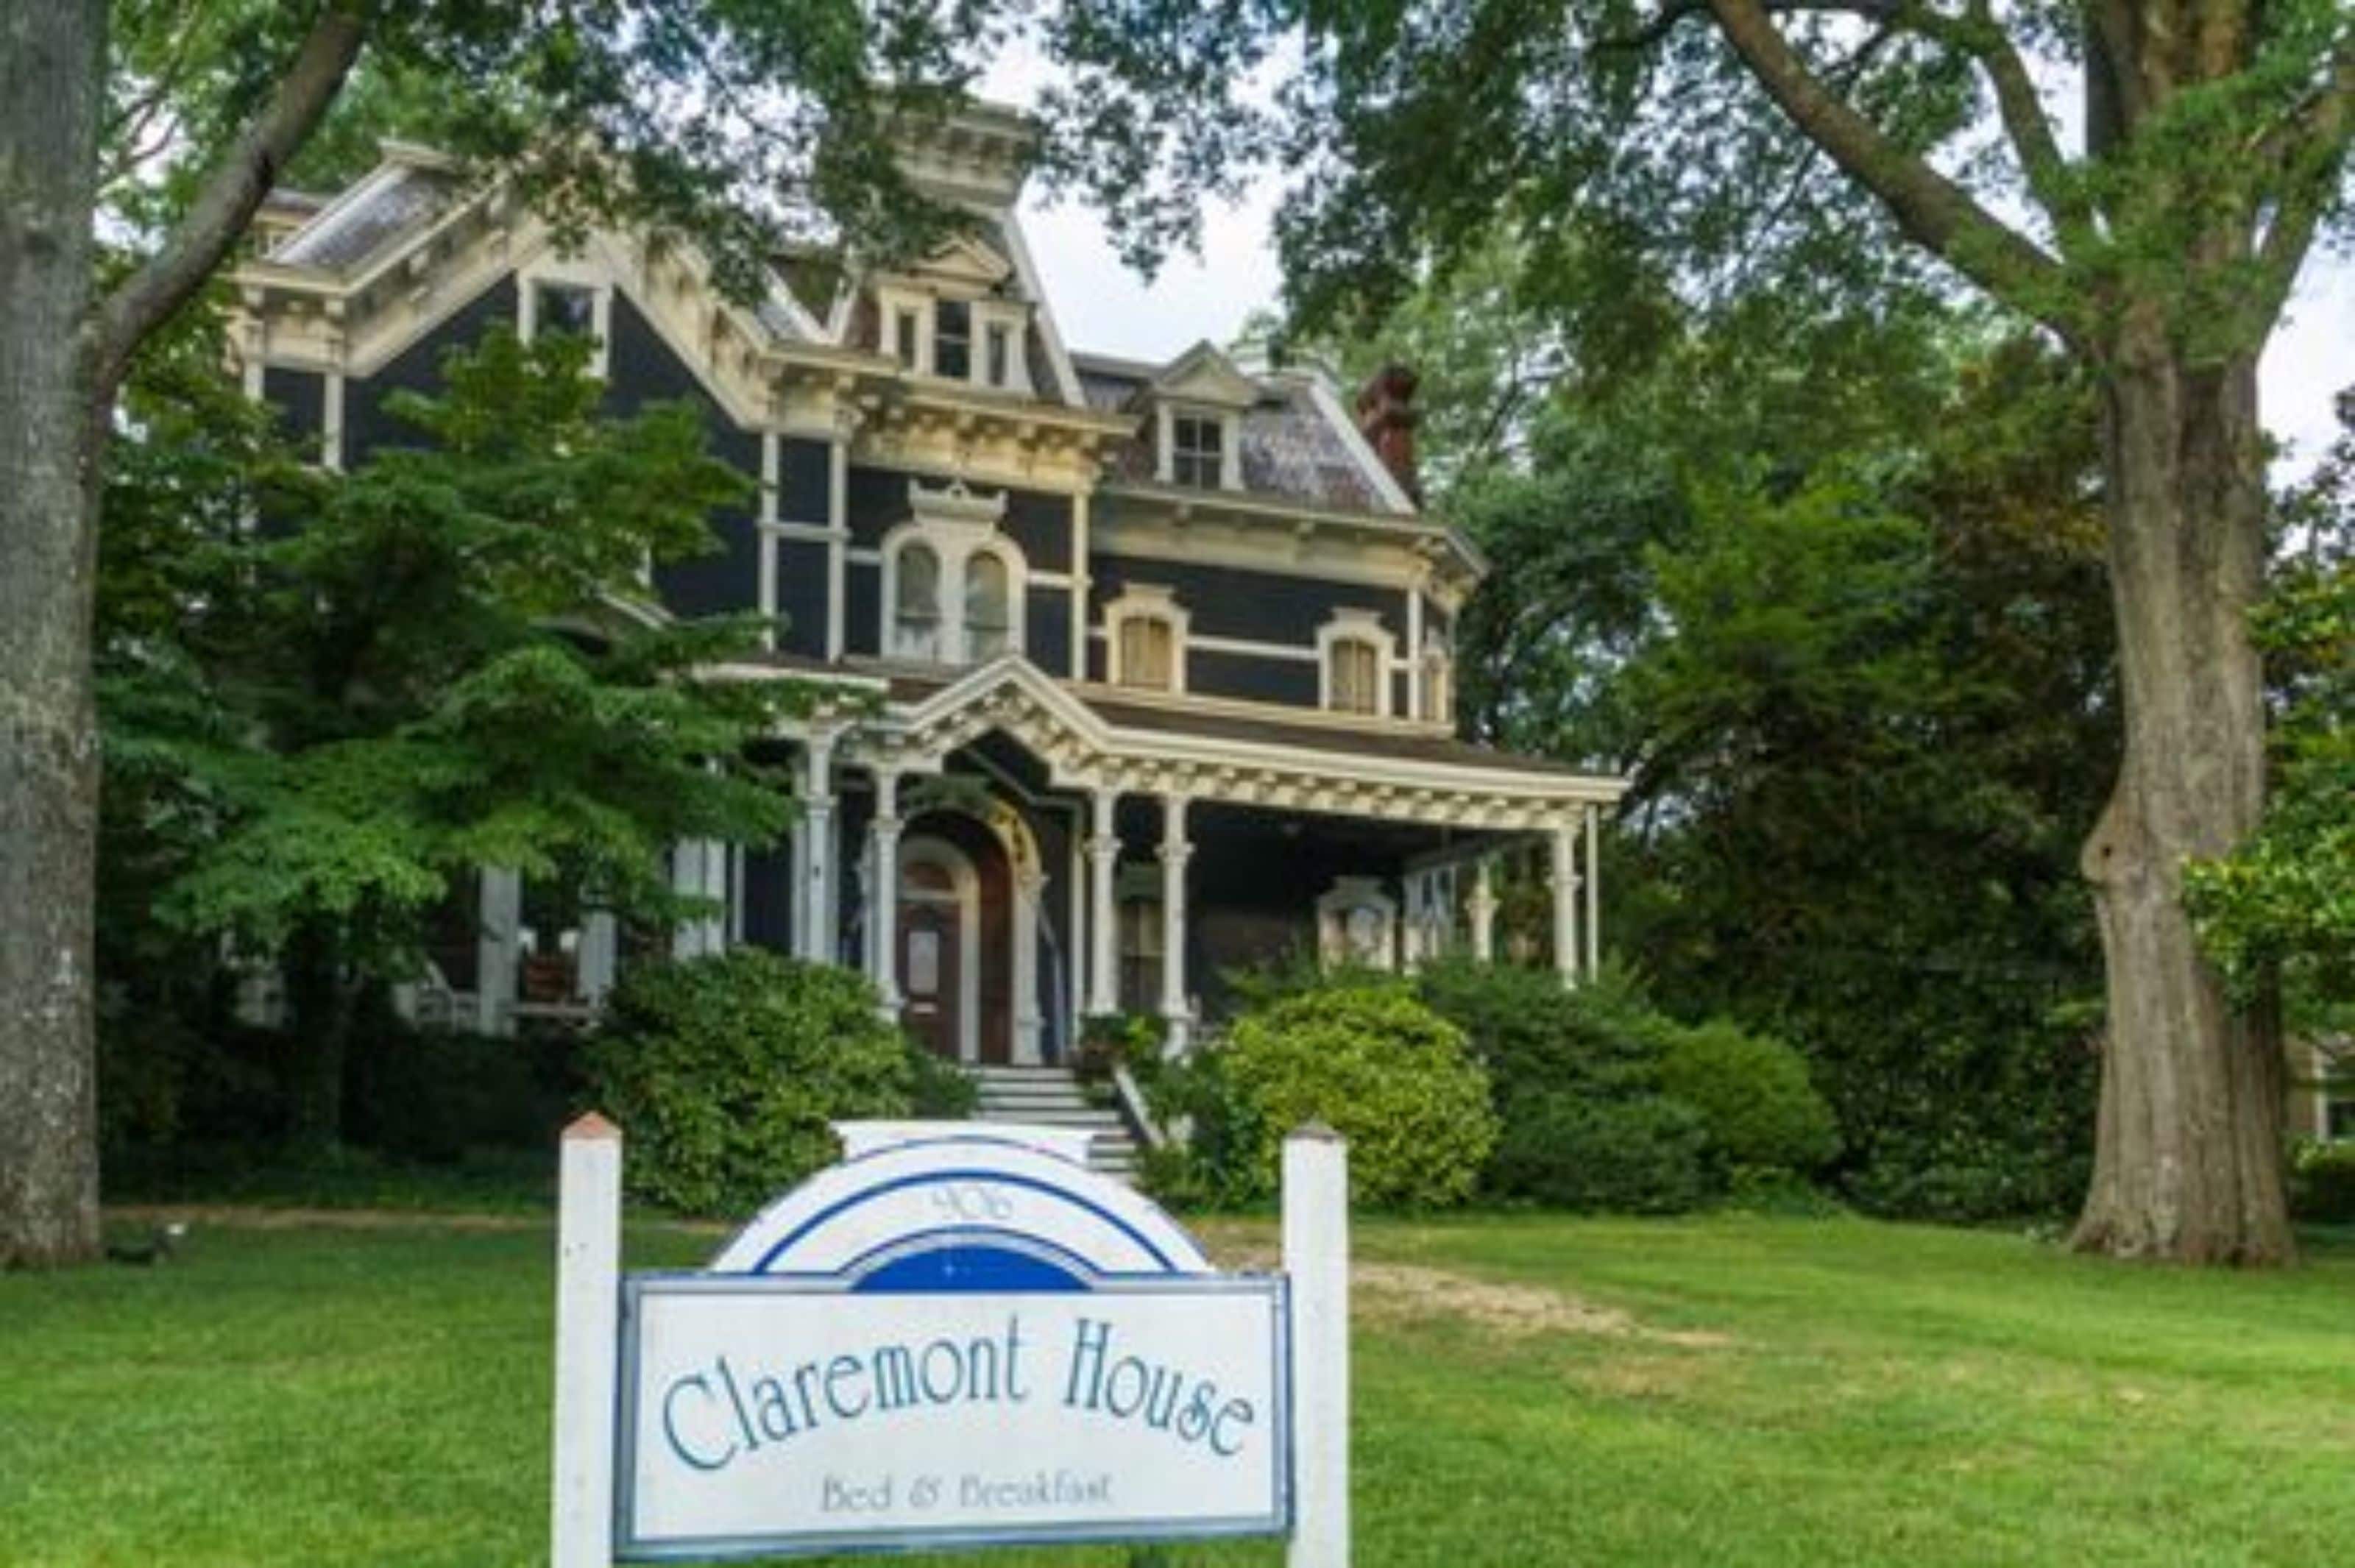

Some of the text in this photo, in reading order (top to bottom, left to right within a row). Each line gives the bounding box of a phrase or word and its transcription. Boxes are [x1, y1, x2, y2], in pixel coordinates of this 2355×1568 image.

[662, 1313, 1253, 1470] Claremont House
[821, 1469, 1113, 1511] Bed & Breakfast
